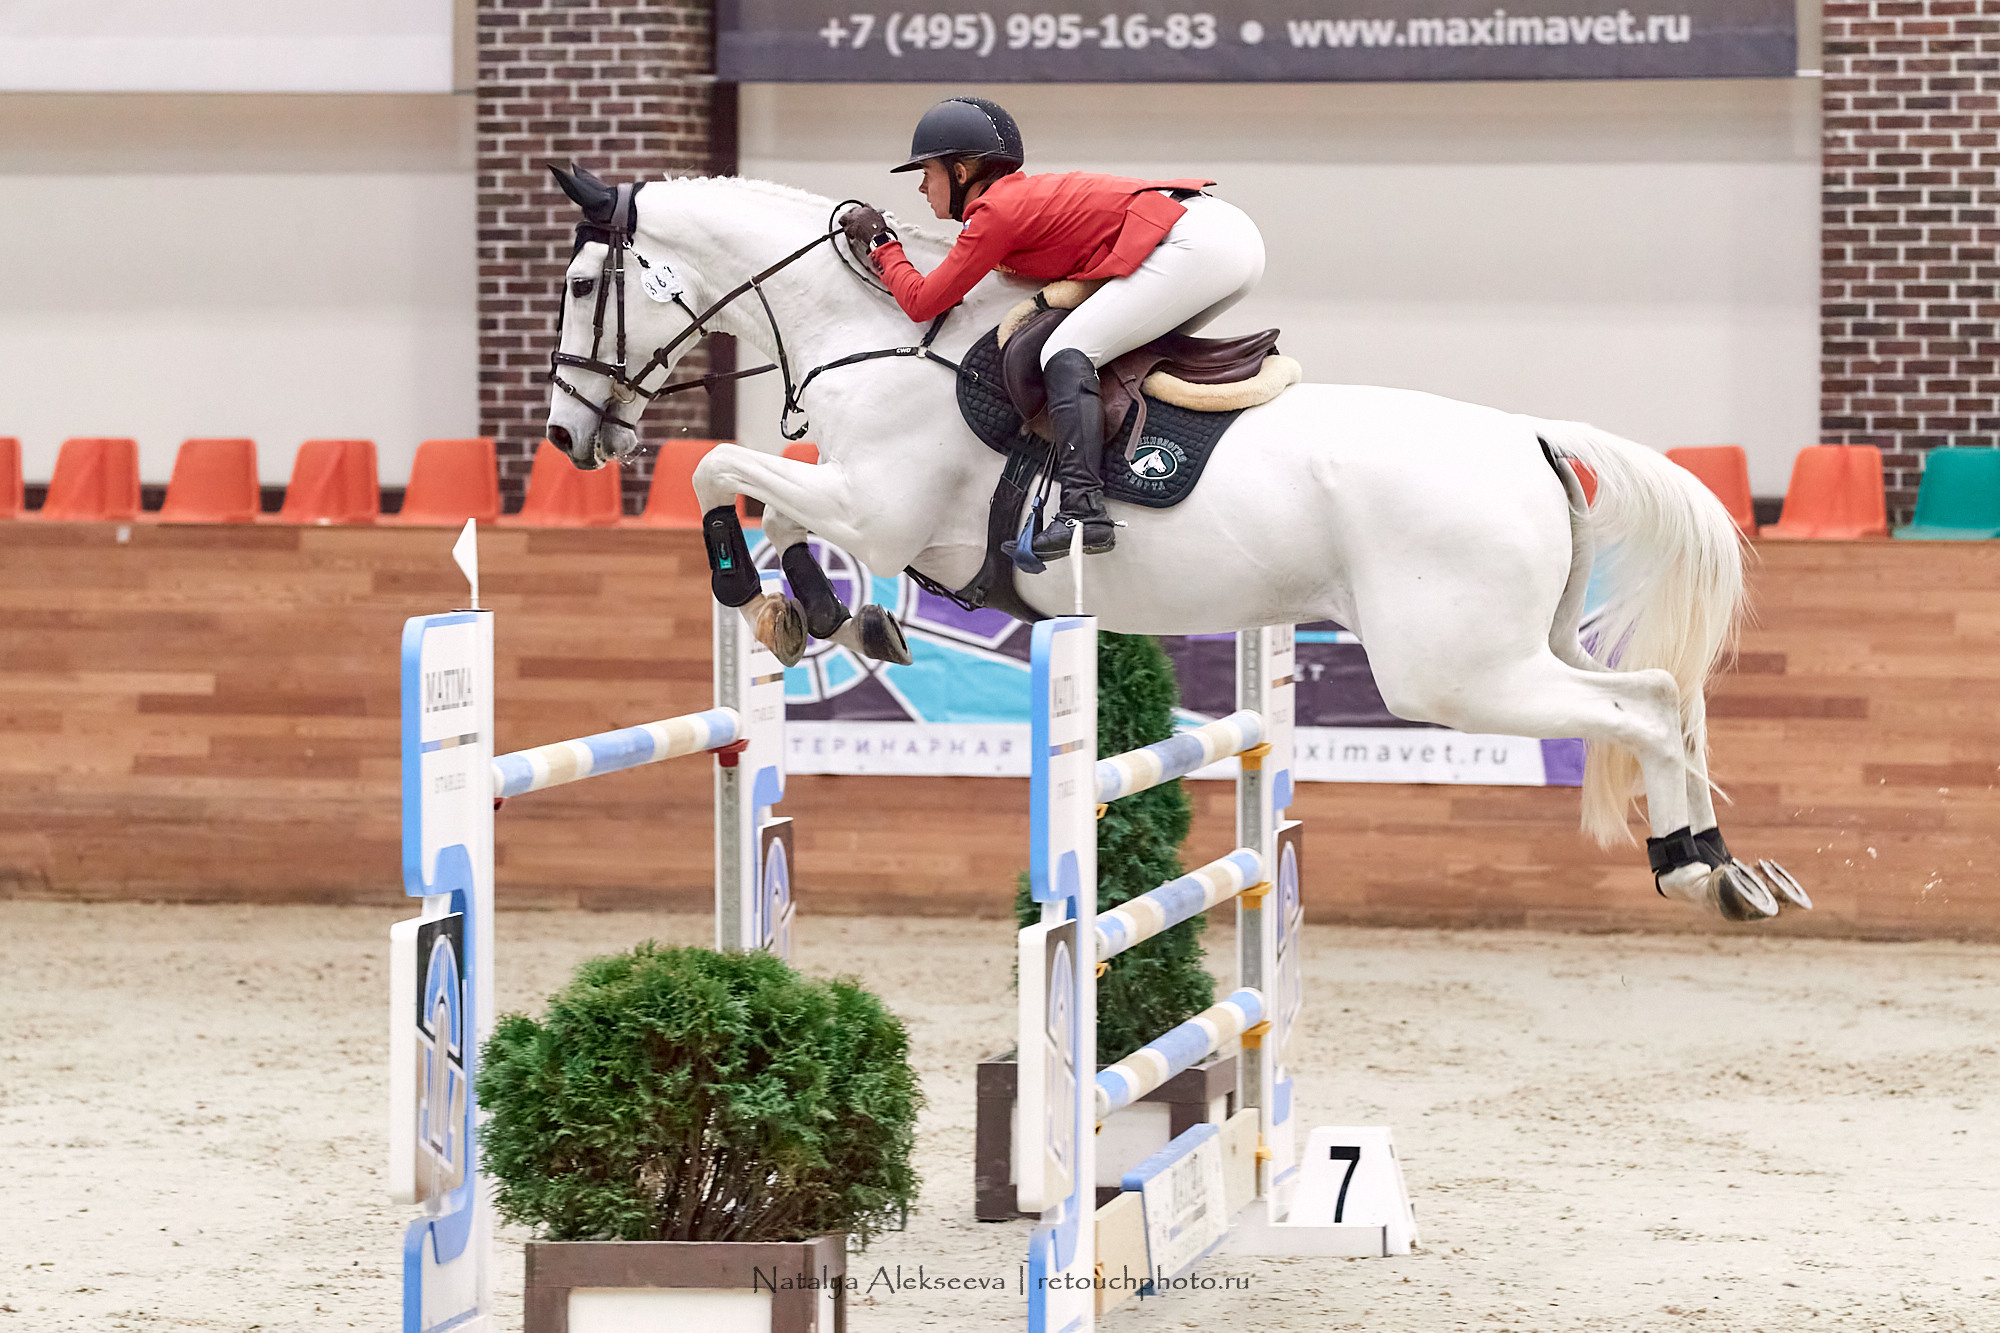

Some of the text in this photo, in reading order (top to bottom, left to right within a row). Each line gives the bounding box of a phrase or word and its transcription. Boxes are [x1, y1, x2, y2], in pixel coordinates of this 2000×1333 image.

[818, 9, 1692, 57] +7 (495) 995-16-83 www.maximavet.ru
[792, 738, 1014, 756] ТЕРИНАРНАЯ
[1294, 738, 1508, 764] ximavet.ru
[1329, 1145, 1361, 1224] 7
